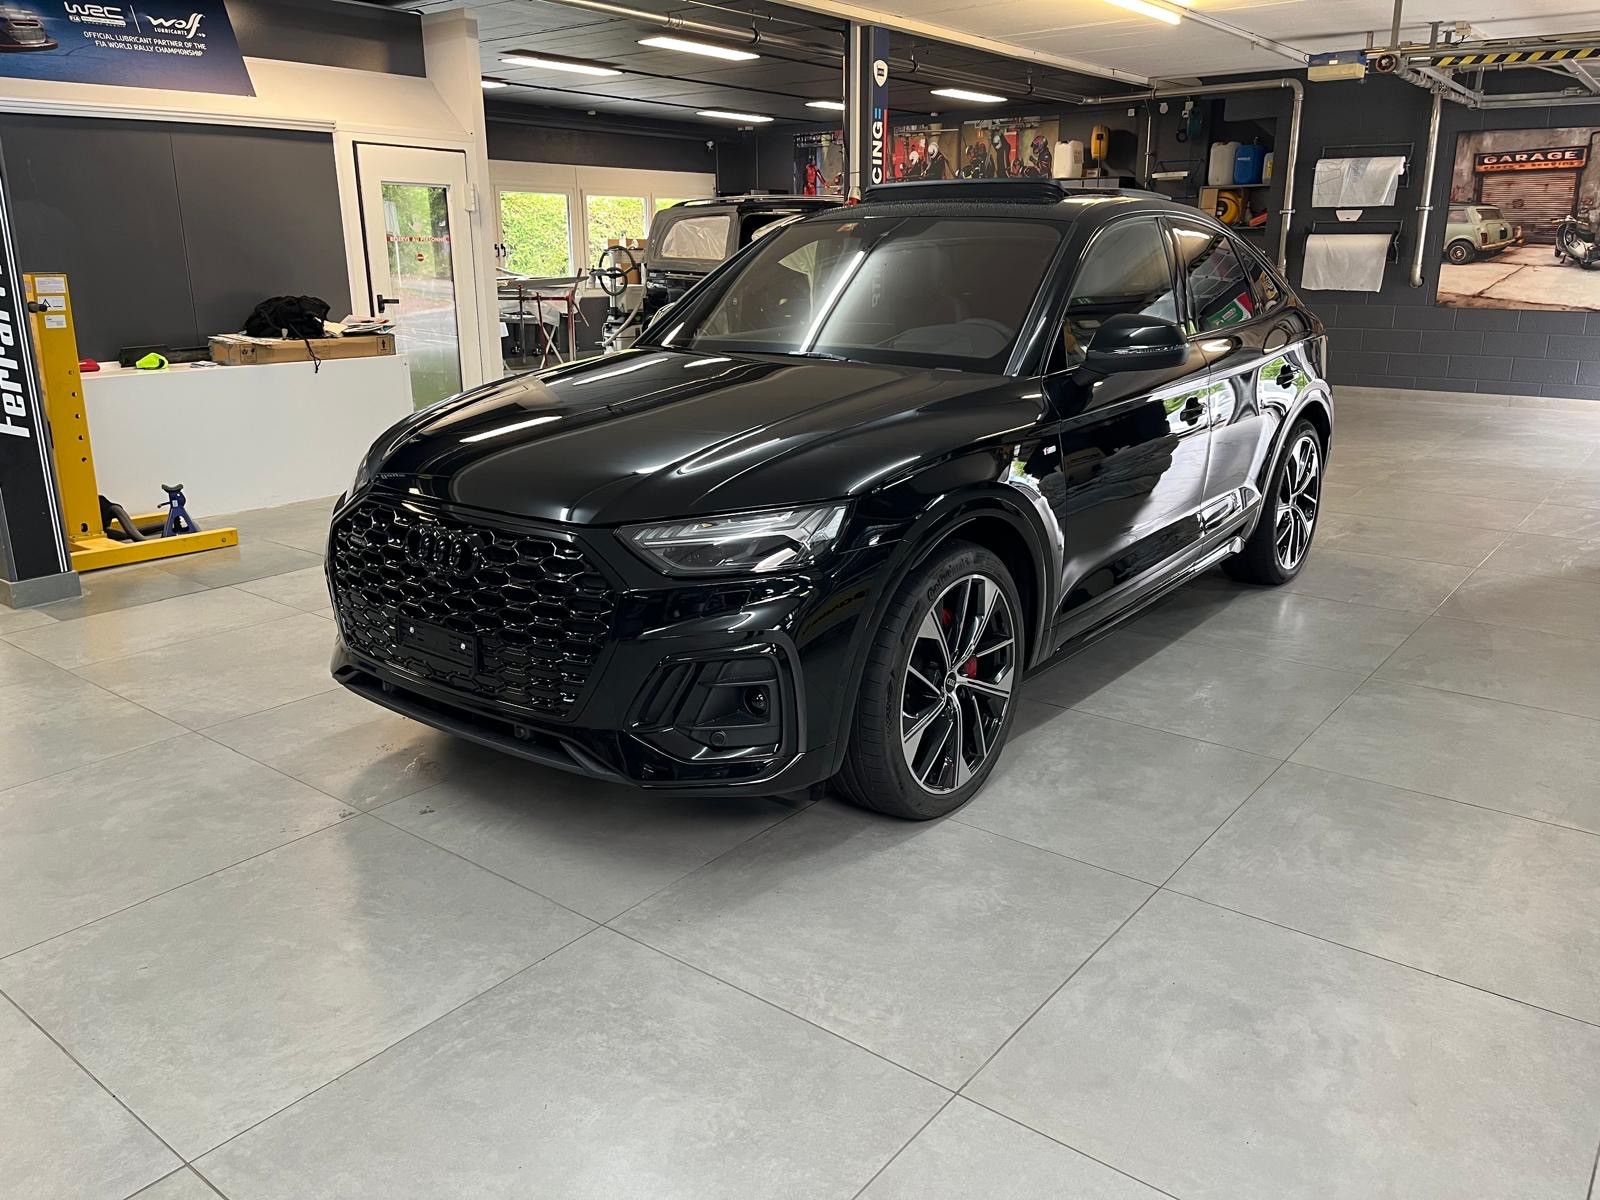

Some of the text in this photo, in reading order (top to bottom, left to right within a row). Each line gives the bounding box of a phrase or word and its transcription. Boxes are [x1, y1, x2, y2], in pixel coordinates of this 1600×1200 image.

[64, 1, 124, 19] WRC
[154, 27, 188, 36] LUBRICANTS
[83, 31, 115, 41] OFFICIAL
[115, 34, 152, 45] LUBRICANT
[153, 38, 183, 48] PARTNER
[193, 42, 207, 50] THE
[95, 40, 203, 57] FIA WORLD RALLY CHAMPIONSHIP
[1484, 151, 1578, 164] GARAGE
